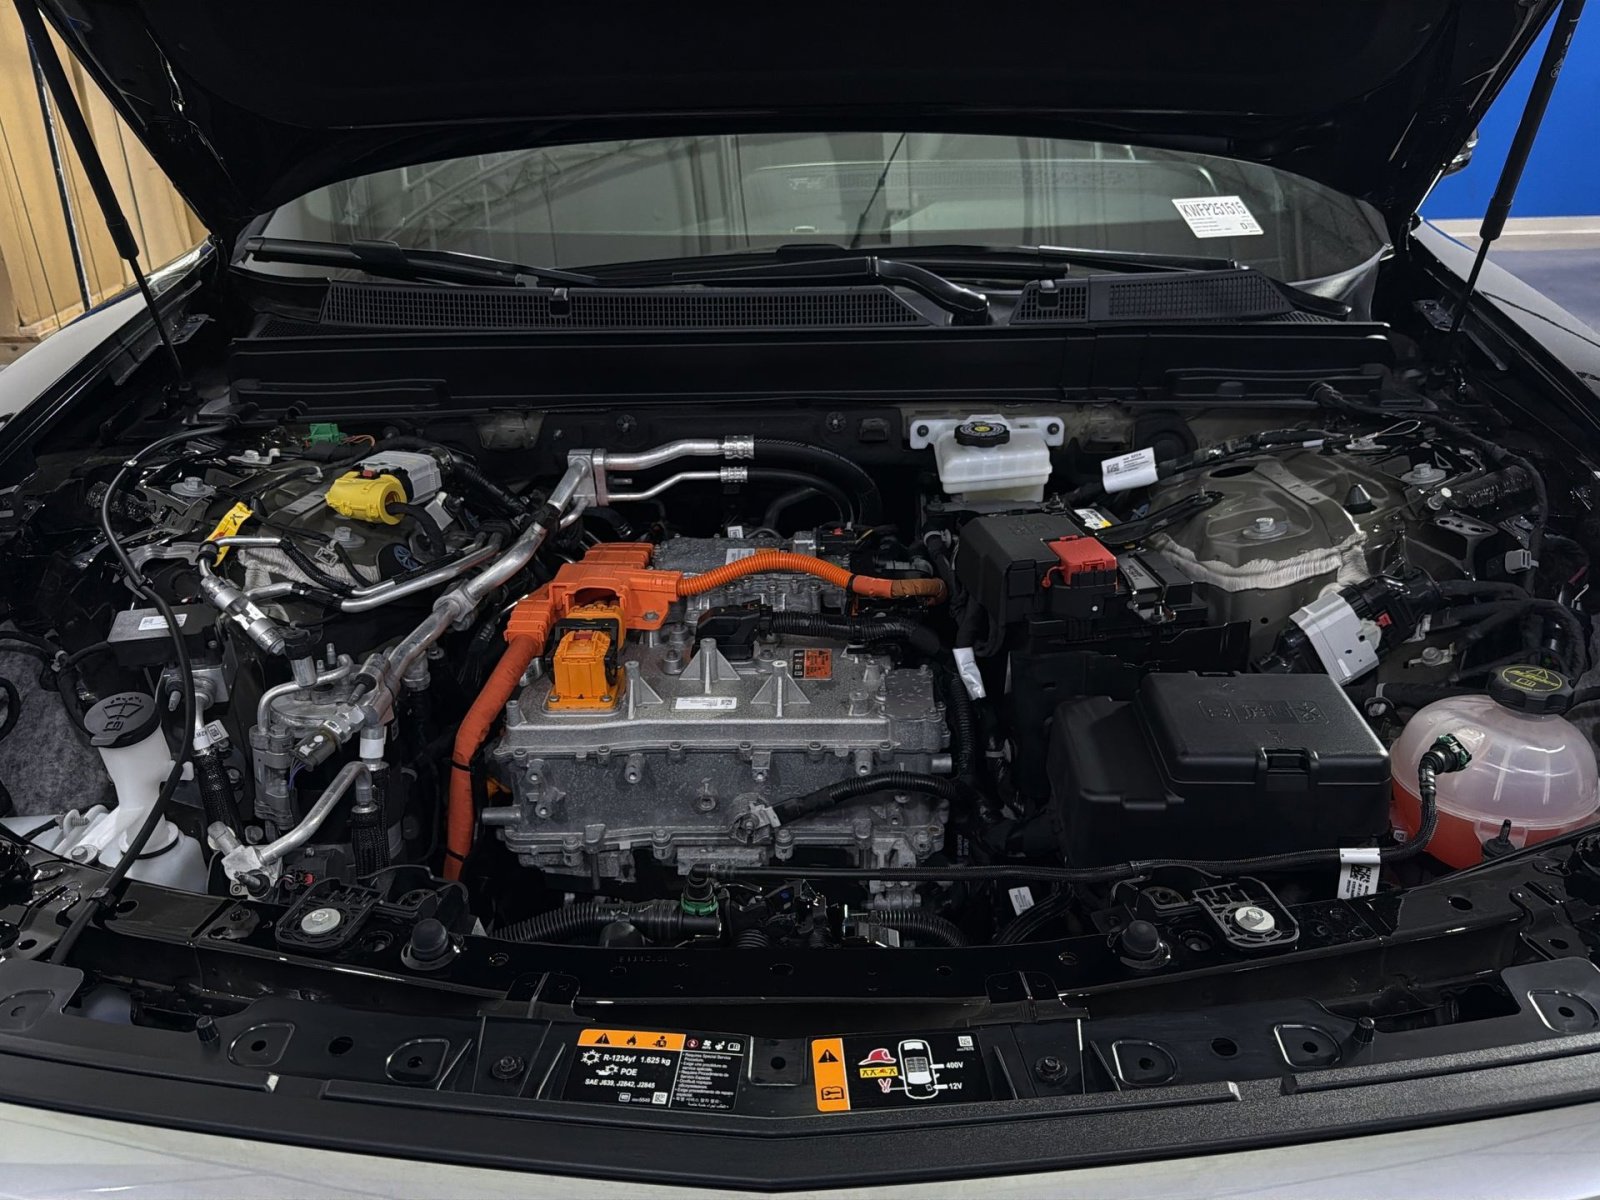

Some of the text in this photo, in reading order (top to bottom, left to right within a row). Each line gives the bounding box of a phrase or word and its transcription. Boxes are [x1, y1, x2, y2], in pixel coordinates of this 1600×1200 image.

[1179, 202, 1247, 217] KWFP251515
[602, 1054, 671, 1067] R-1234yf 1.625 kg
[945, 1061, 964, 1069] 400V
[620, 1068, 638, 1076] POE
[584, 1078, 599, 1086] SAE
[948, 1082, 963, 1090] 12V
